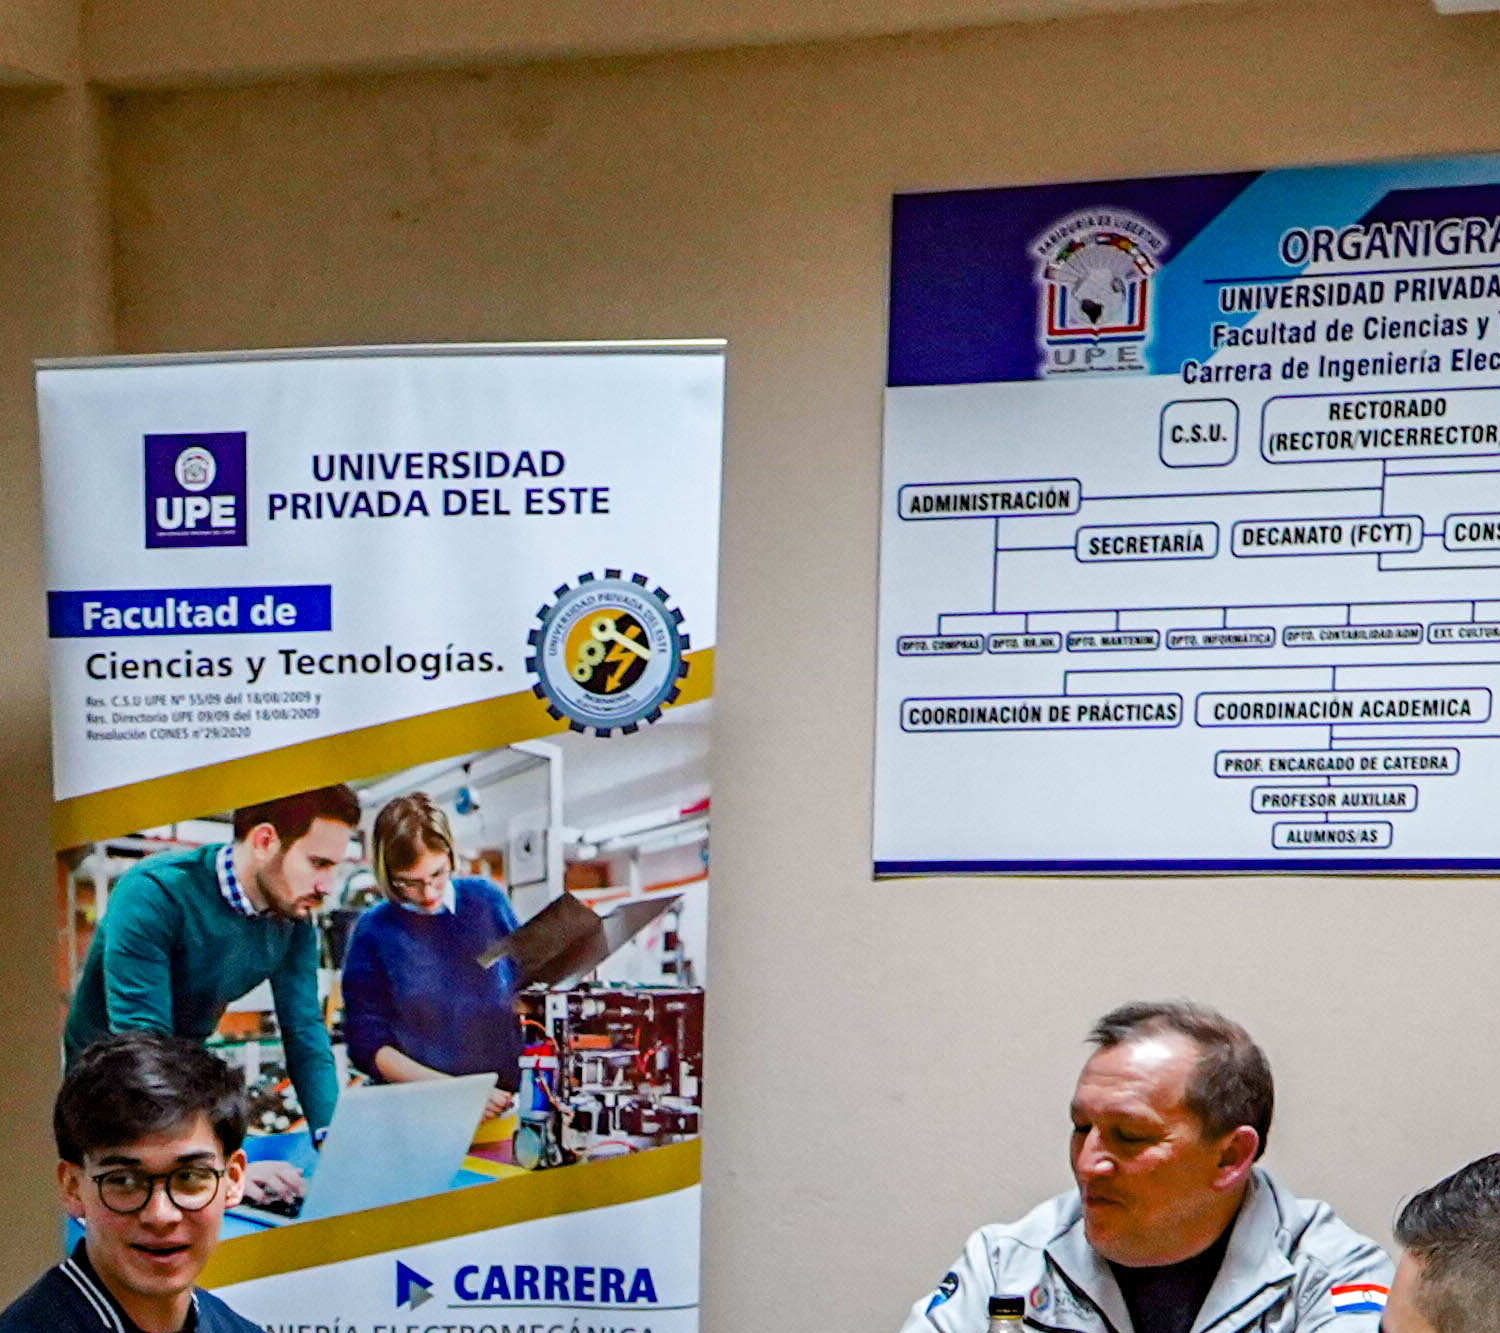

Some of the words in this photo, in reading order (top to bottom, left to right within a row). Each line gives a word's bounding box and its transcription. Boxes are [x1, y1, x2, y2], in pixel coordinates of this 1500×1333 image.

[1220, 280, 1385, 313] UNIVERSIDAD
[1394, 275, 1500, 304] PRIVADA
[1212, 320, 1316, 349] Facultad
[1325, 317, 1354, 342] de
[1363, 313, 1469, 341] Ciencias
[1477, 315, 1489, 340] y
[1182, 359, 1272, 385] Carrera
[1281, 355, 1309, 380] de
[1329, 398, 1447, 421] RECTORADO
[1170, 424, 1227, 445] C.S.U.
[311, 448, 567, 483] UNIVERSIDAD
[155, 494, 237, 530] UPE
[267, 490, 430, 521] PRIVADA
[442, 489, 511, 517] DEL
[524, 487, 612, 516] ESTE
[910, 486, 1071, 514] ADMINISTRACIÓN
[1088, 529, 1205, 556] SECRETARÍA
[1242, 526, 1343, 547] DECANATO
[1350, 522, 1412, 546] (FCYT)
[82, 596, 239, 631] Facultad
[250, 594, 298, 627] de
[85, 649, 233, 680] Ciencias
[246, 656, 266, 684] y
[277, 643, 505, 681] Tecnologías.
[909, 703, 1041, 726] COORDINACIÓN
[1048, 706, 1070, 722] DE
[1077, 699, 1177, 722] PRÁCTICAS
[1224, 758, 1263, 772] PROF.
[1268, 756, 1355, 772] ENCARGADO
[1360, 755, 1378, 770] DE
[1382, 755, 1449, 770] CATEDRA
[1261, 793, 1336, 808] PROFESOR
[1340, 792, 1407, 807] AUXILIAR
[1286, 829, 1378, 844] ALUMNOS/AS
[453, 1263, 659, 1304] CARRERA
